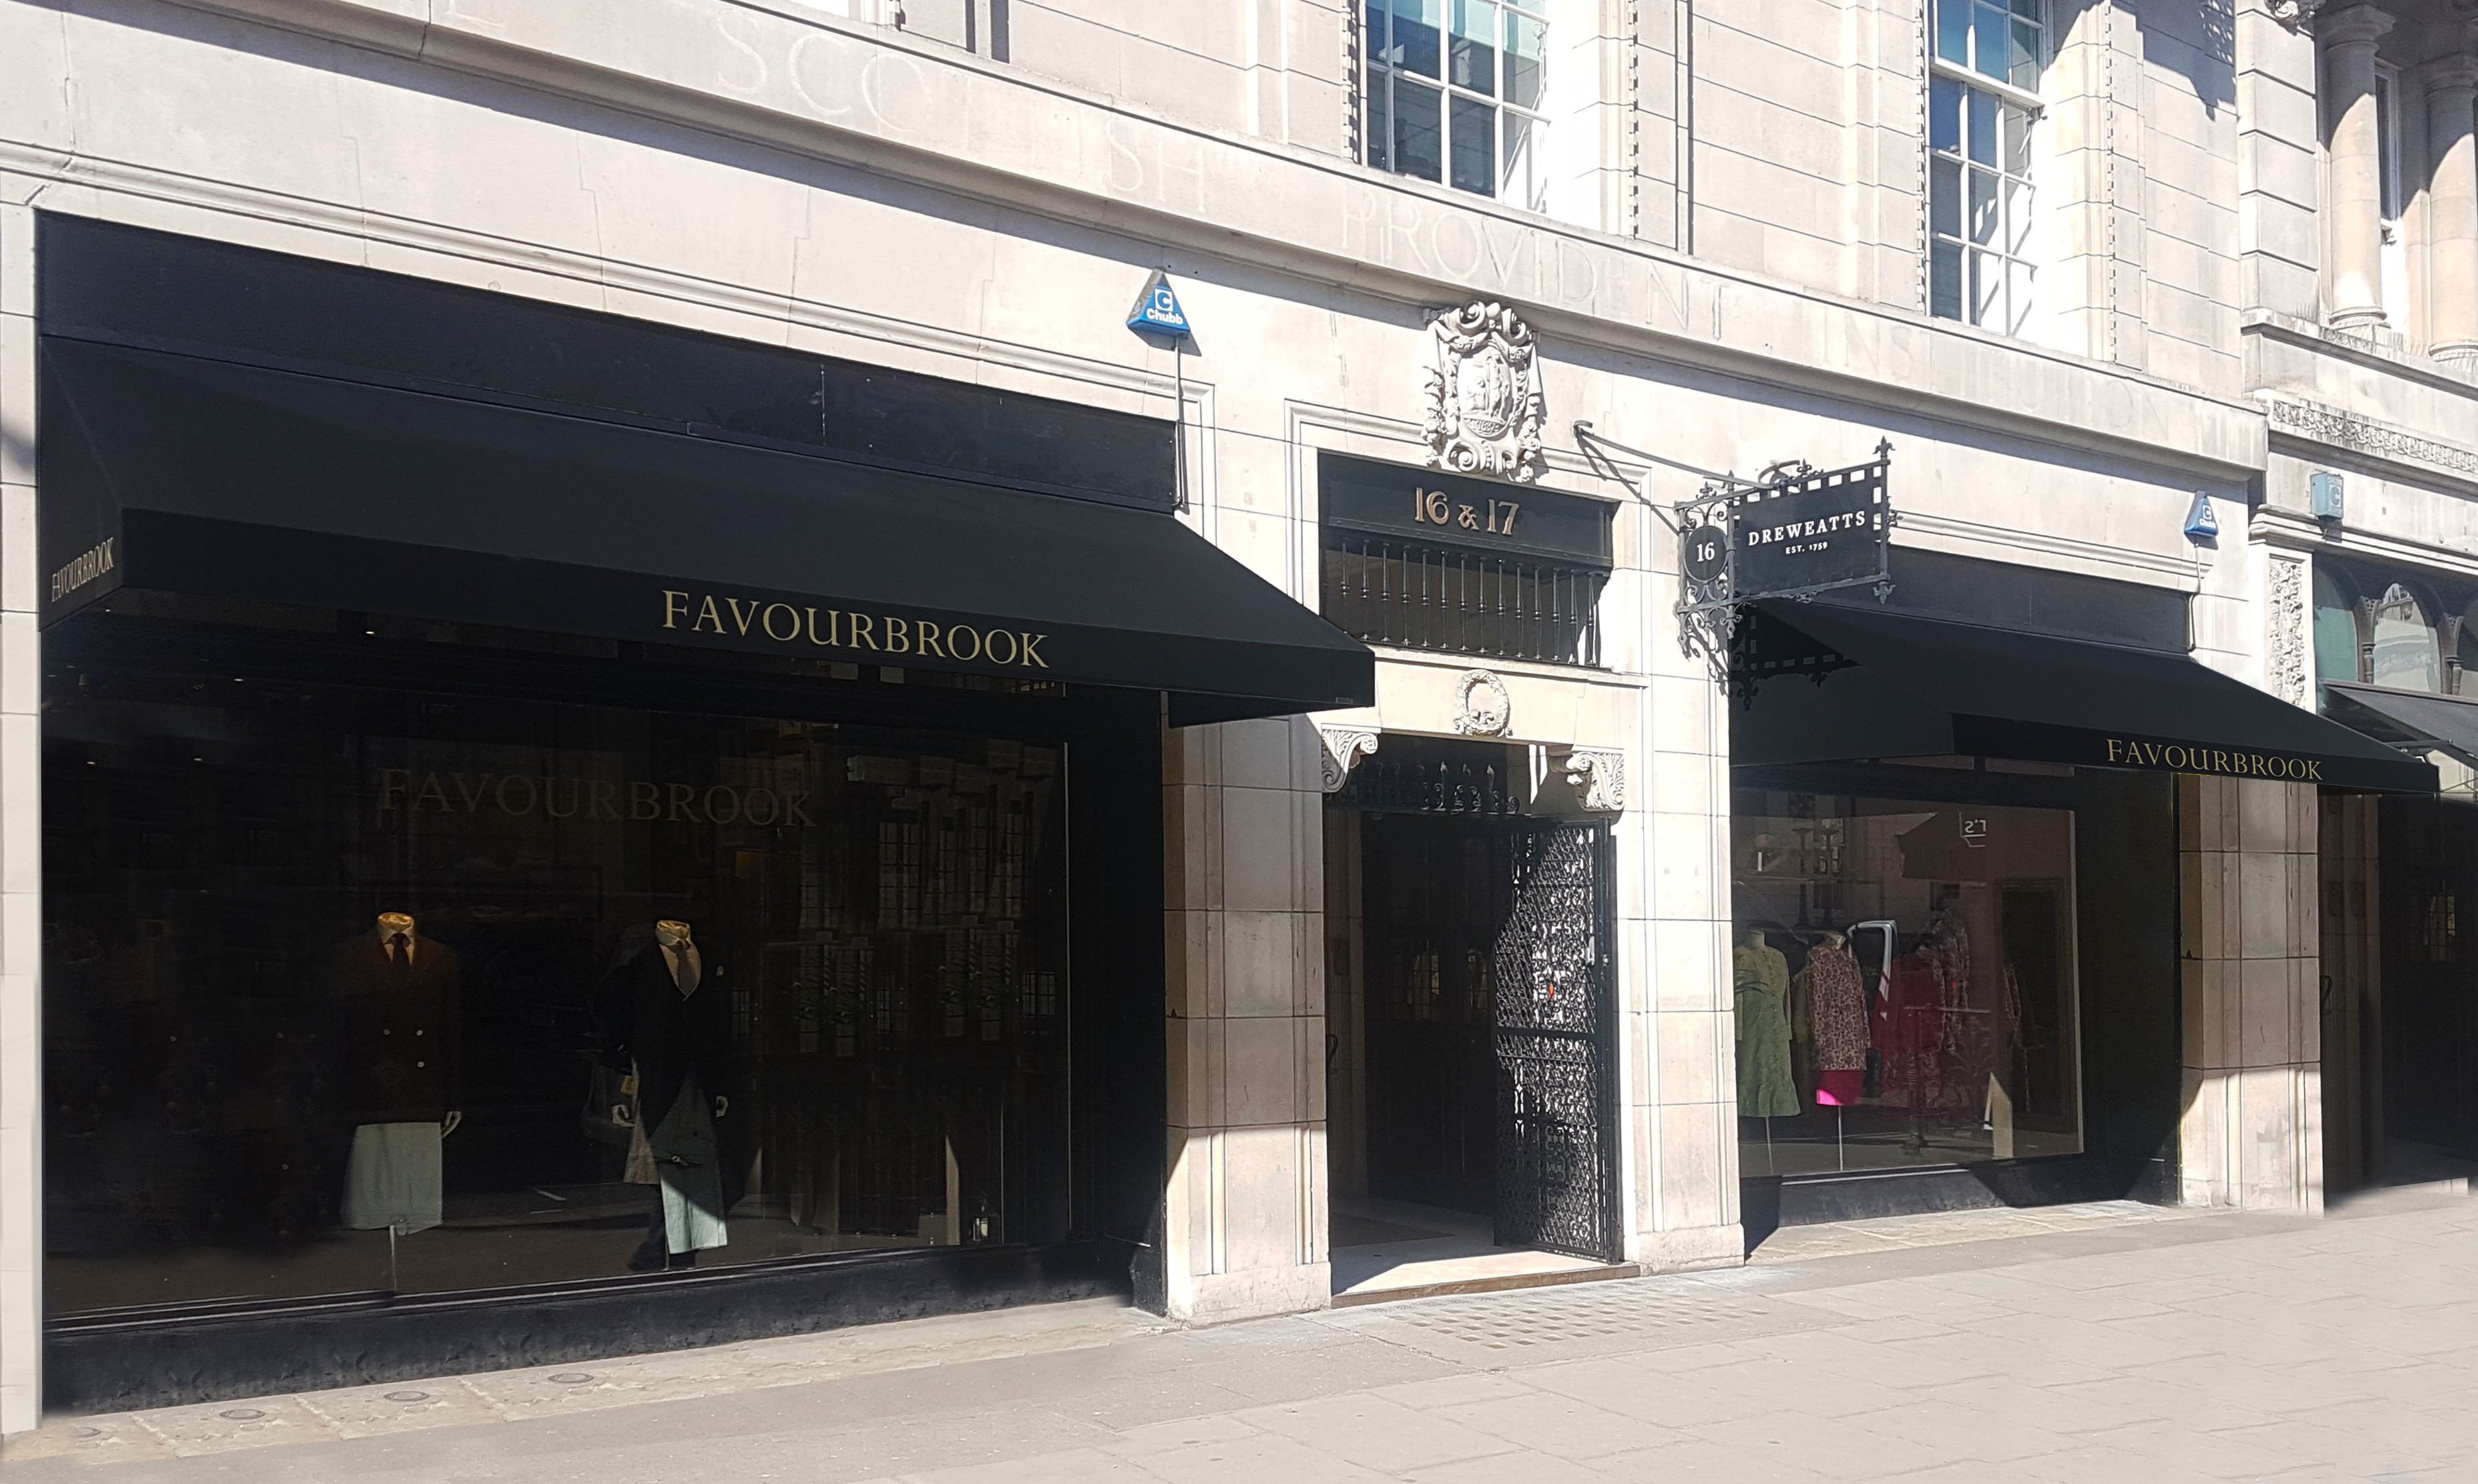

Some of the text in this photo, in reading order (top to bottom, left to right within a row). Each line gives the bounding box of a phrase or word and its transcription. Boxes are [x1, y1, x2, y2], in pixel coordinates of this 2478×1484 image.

[1146, 308, 1184, 325] Chubb
[1415, 487, 1519, 535] 16 & 17
[1748, 510, 1866, 546] DREWEATTS
[1696, 541, 1716, 562] 16
[1785, 541, 1828, 555] EST. 1759
[662, 589, 1049, 668] FAVOURBROOK
[2105, 738, 2323, 780] FAVOURBROOK
[376, 767, 818, 828] FAVOURBROOK
